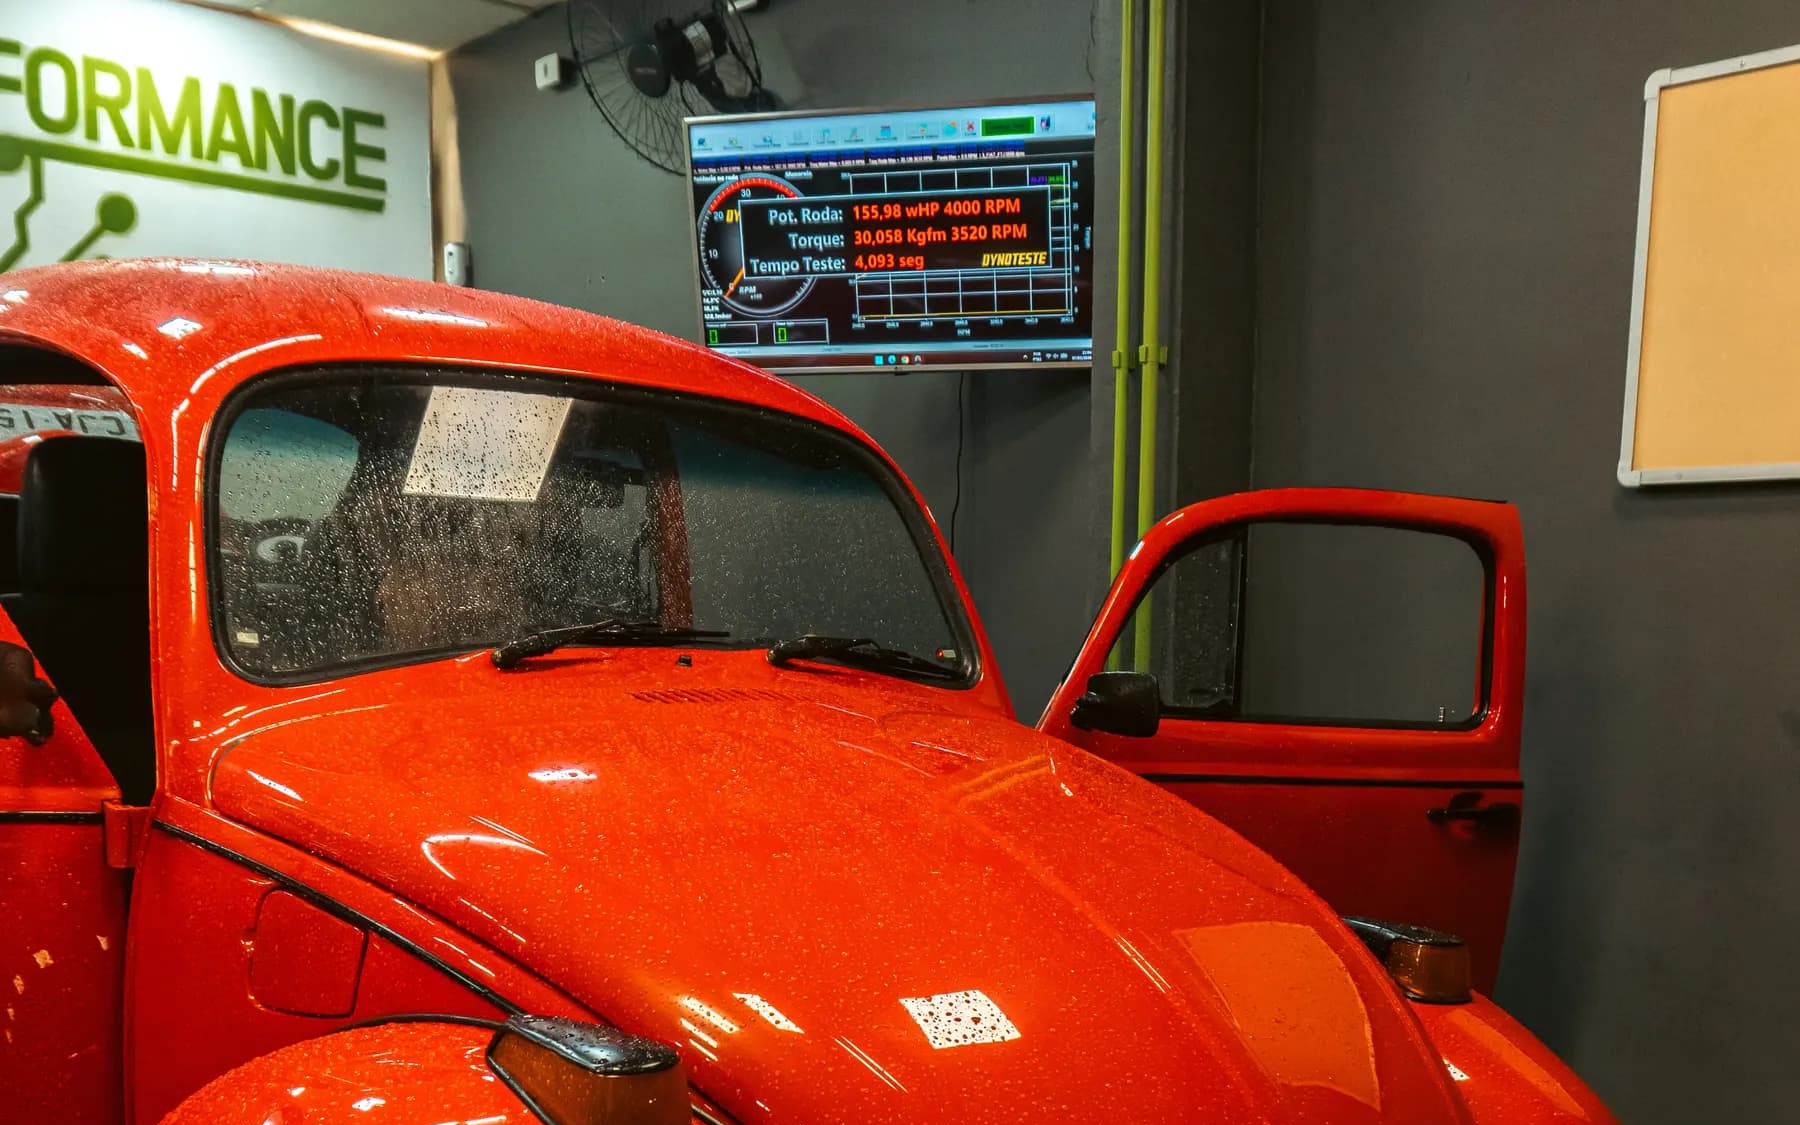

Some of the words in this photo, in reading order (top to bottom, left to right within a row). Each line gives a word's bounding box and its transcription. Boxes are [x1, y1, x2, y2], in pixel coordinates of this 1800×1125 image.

[741, 188, 751, 199] 30
[768, 208, 798, 226] Pot.
[801, 206, 844, 224] Roda:
[853, 204, 902, 221] 155,98
[905, 202, 940, 217] wHP
[943, 200, 981, 216] 4000
[985, 198, 1021, 214] RPM
[788, 232, 845, 251] Torque:
[854, 229, 902, 246] 30,058
[906, 227, 947, 246] Kgfm
[951, 225, 988, 241] 3520
[991, 223, 1028, 239] RPM
[708, 249, 719, 259] 10
[981, 251, 1048, 268] DYNOTESTE
[750, 258, 800, 275] Tempo
[802, 255, 846, 272] Teste:
[854, 253, 895, 271] 4,093
[899, 255, 925, 270] seg
